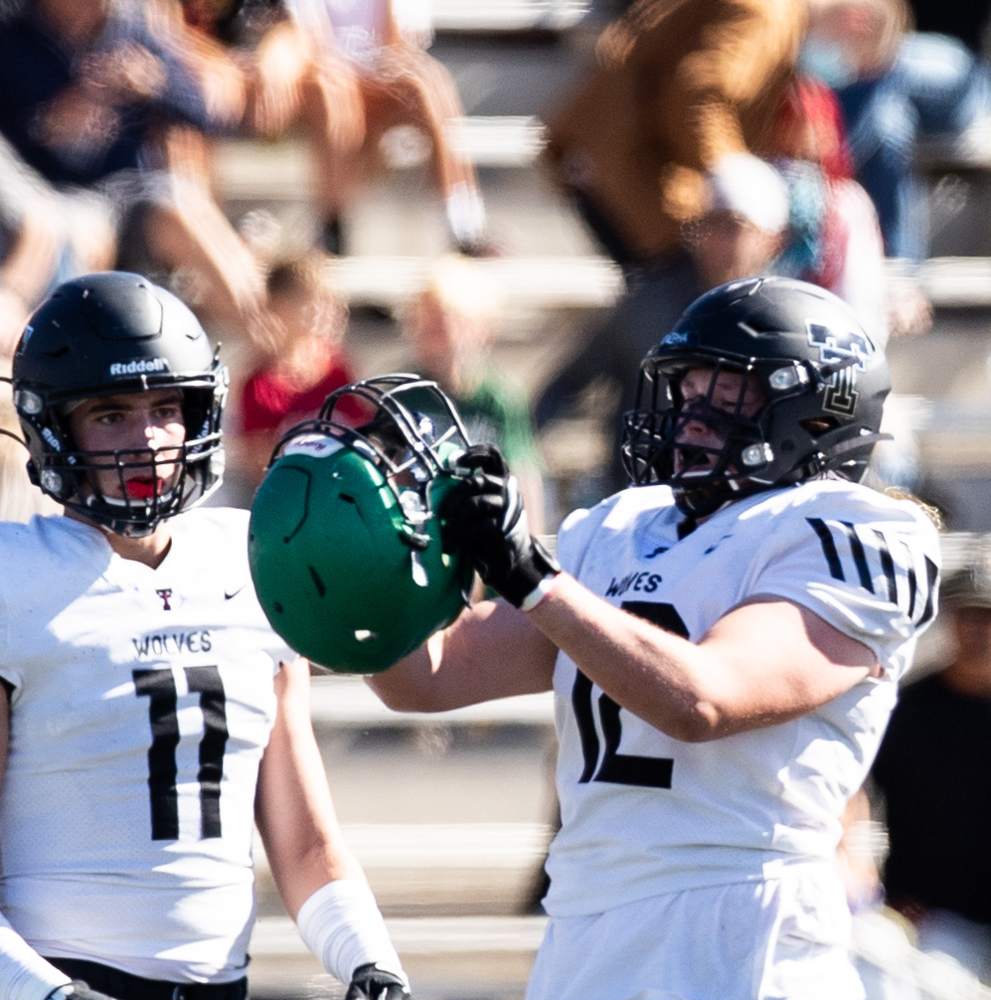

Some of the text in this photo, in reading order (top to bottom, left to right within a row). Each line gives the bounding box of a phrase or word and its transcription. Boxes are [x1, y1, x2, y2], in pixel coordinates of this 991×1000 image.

[110, 358, 165, 376] Riddell
[132, 629, 212, 658] WOLVES
[131, 665, 230, 841] 11
